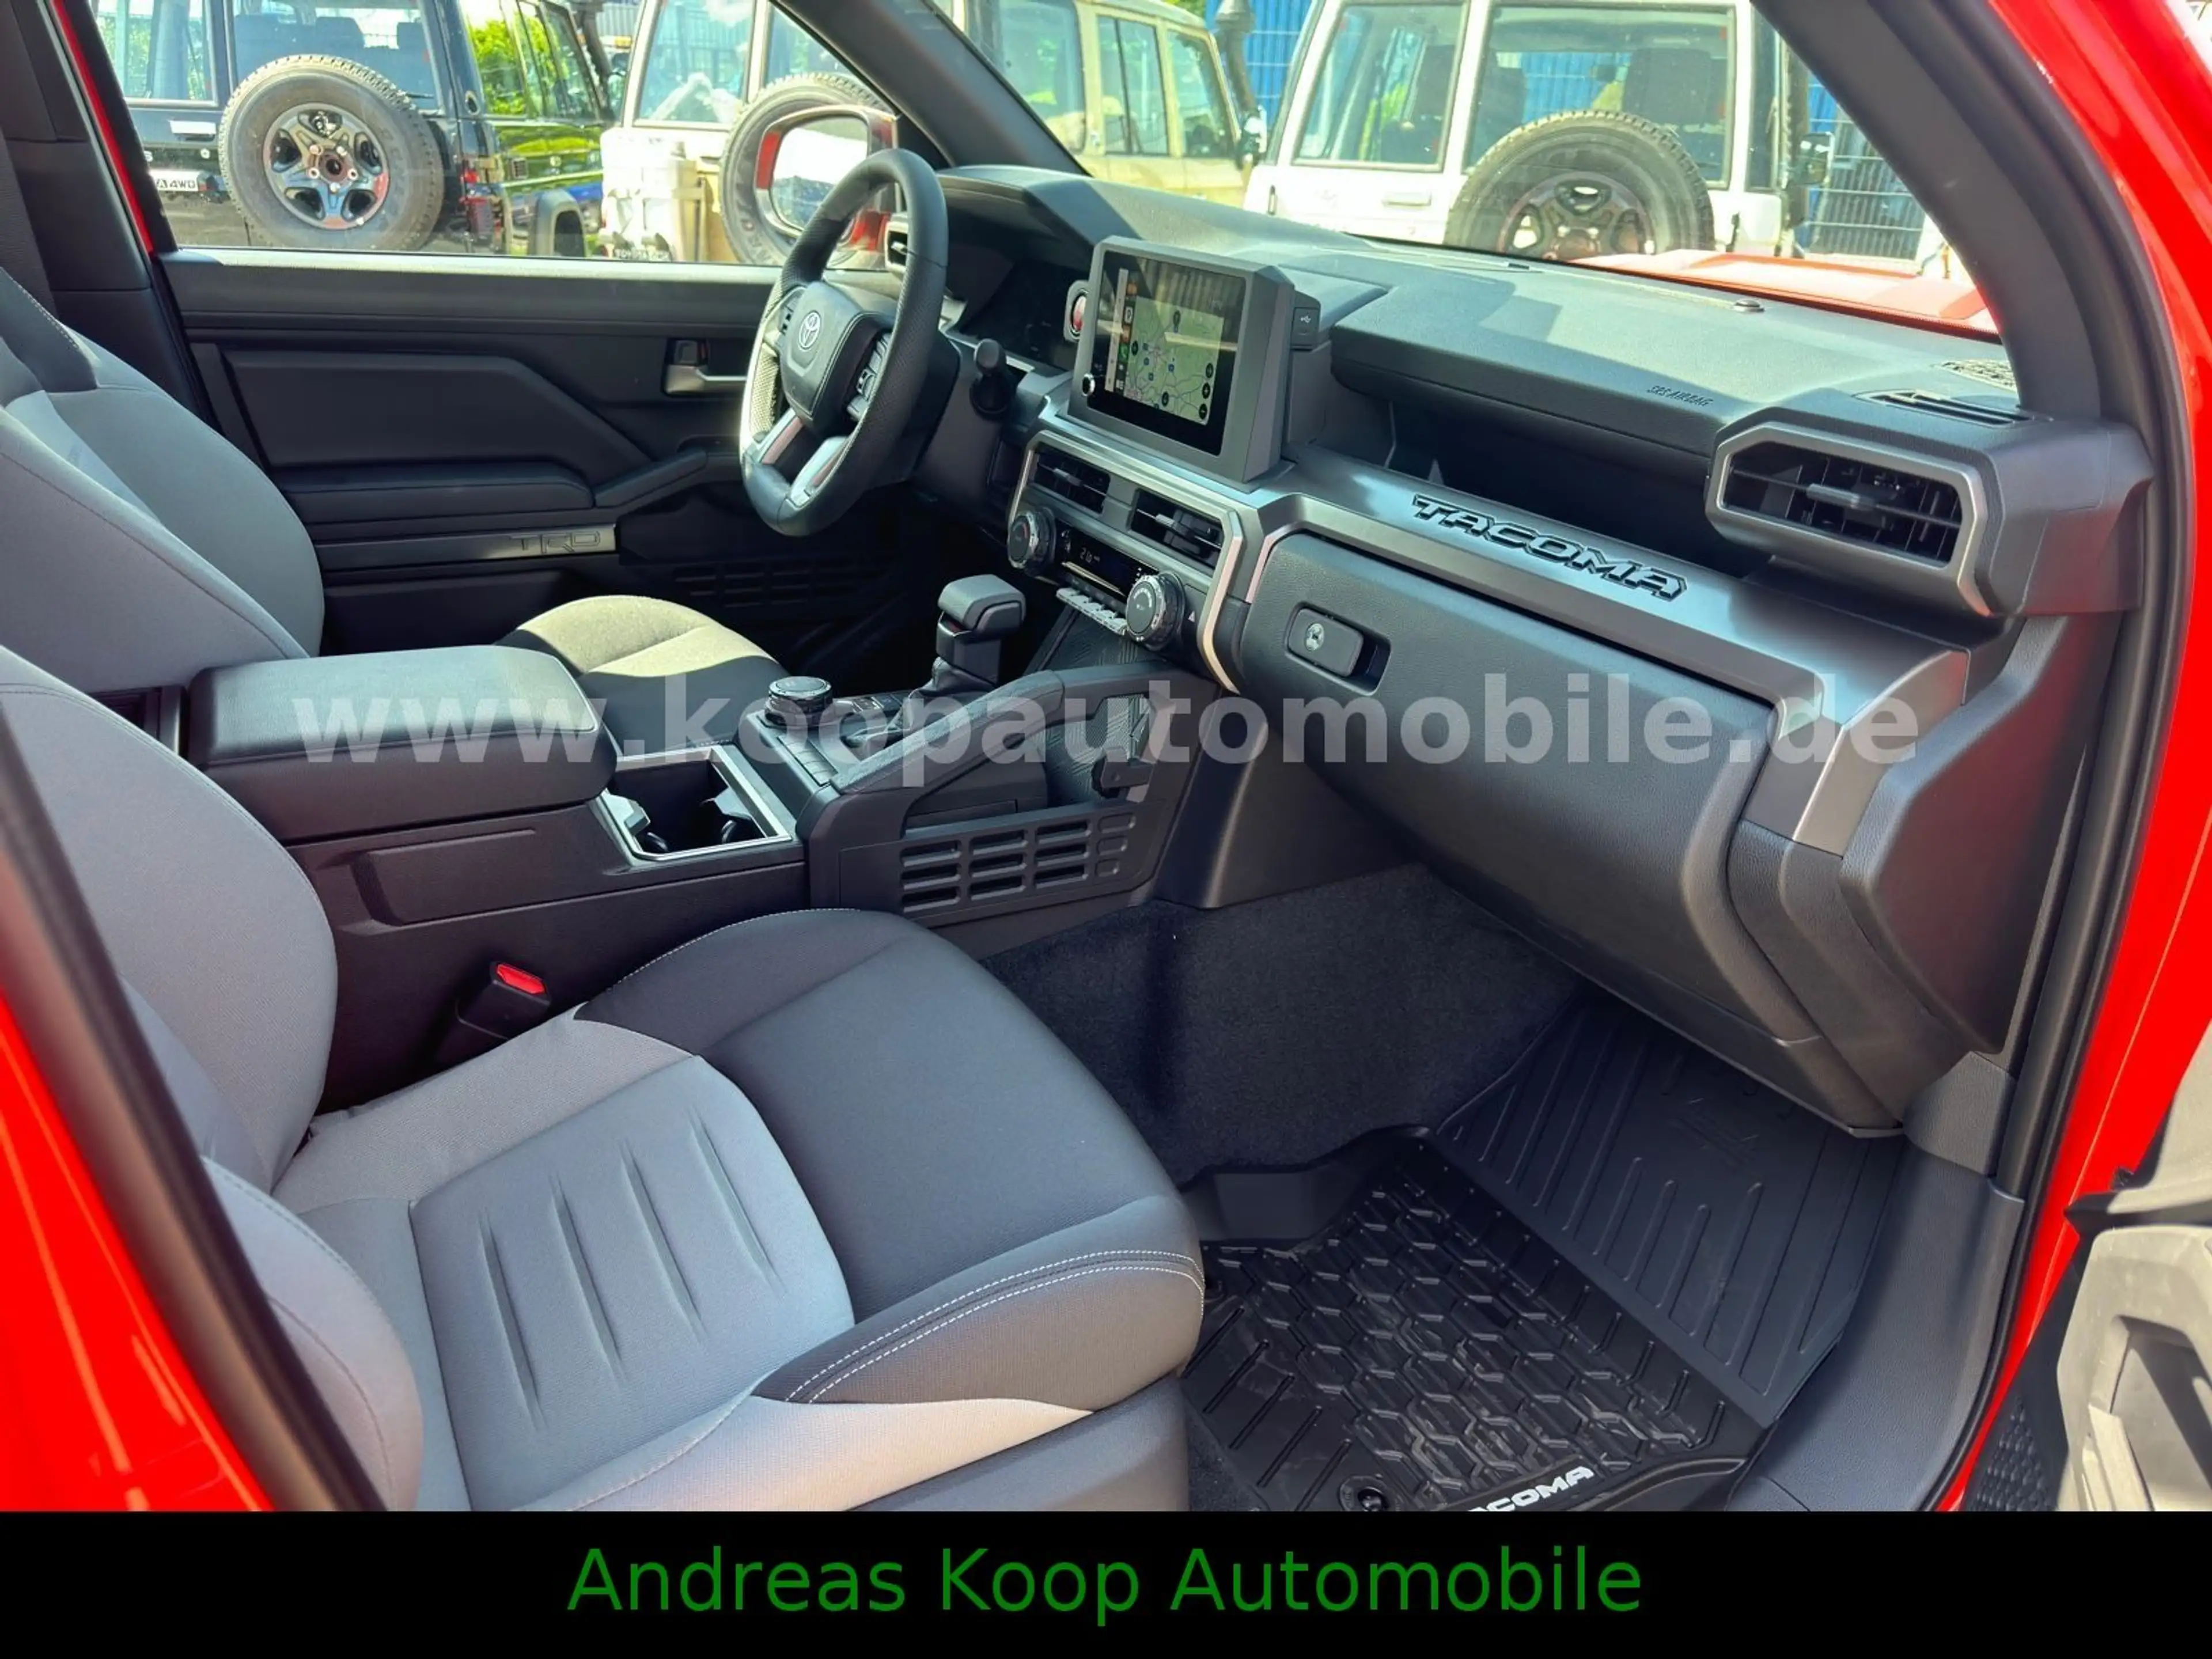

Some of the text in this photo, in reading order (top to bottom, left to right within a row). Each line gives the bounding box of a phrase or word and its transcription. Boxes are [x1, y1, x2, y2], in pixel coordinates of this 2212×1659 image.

[510, 530, 601, 555] TRD
[1412, 493, 1687, 601] TACOMA
[1468, 1465, 1595, 1512] COMA
